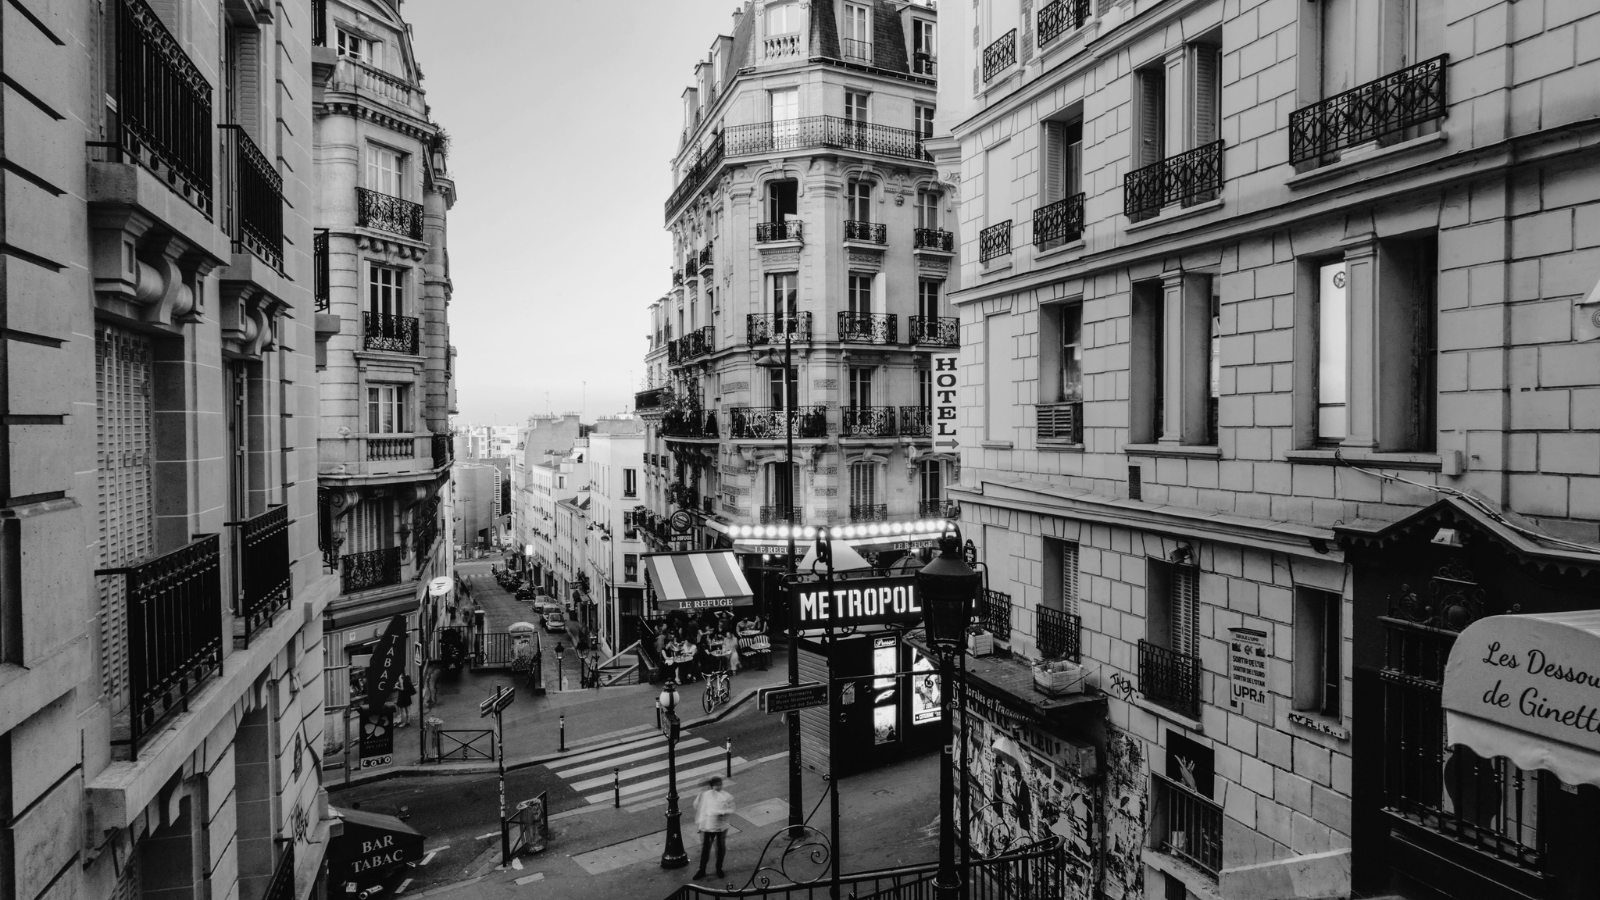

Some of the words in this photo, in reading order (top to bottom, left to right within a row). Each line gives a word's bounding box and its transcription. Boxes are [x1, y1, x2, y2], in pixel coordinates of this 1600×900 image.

[935, 357, 957, 436] HOTEL
[679, 601, 692, 609] LE
[694, 599, 734, 608] REFUGE
[800, 585, 922, 621] METROPOL
[377, 634, 400, 691] TABAC
[1232, 655, 1248, 665] SORTIR
[1482, 641, 1520, 669] Les
[1526, 648, 1600, 689] Dessou
[965, 683, 986, 705] lorales
[1482, 679, 1511, 708] de
[362, 755, 391, 767] LOTO
[362, 834, 394, 853] BAR
[351, 849, 403, 873] TABAC
